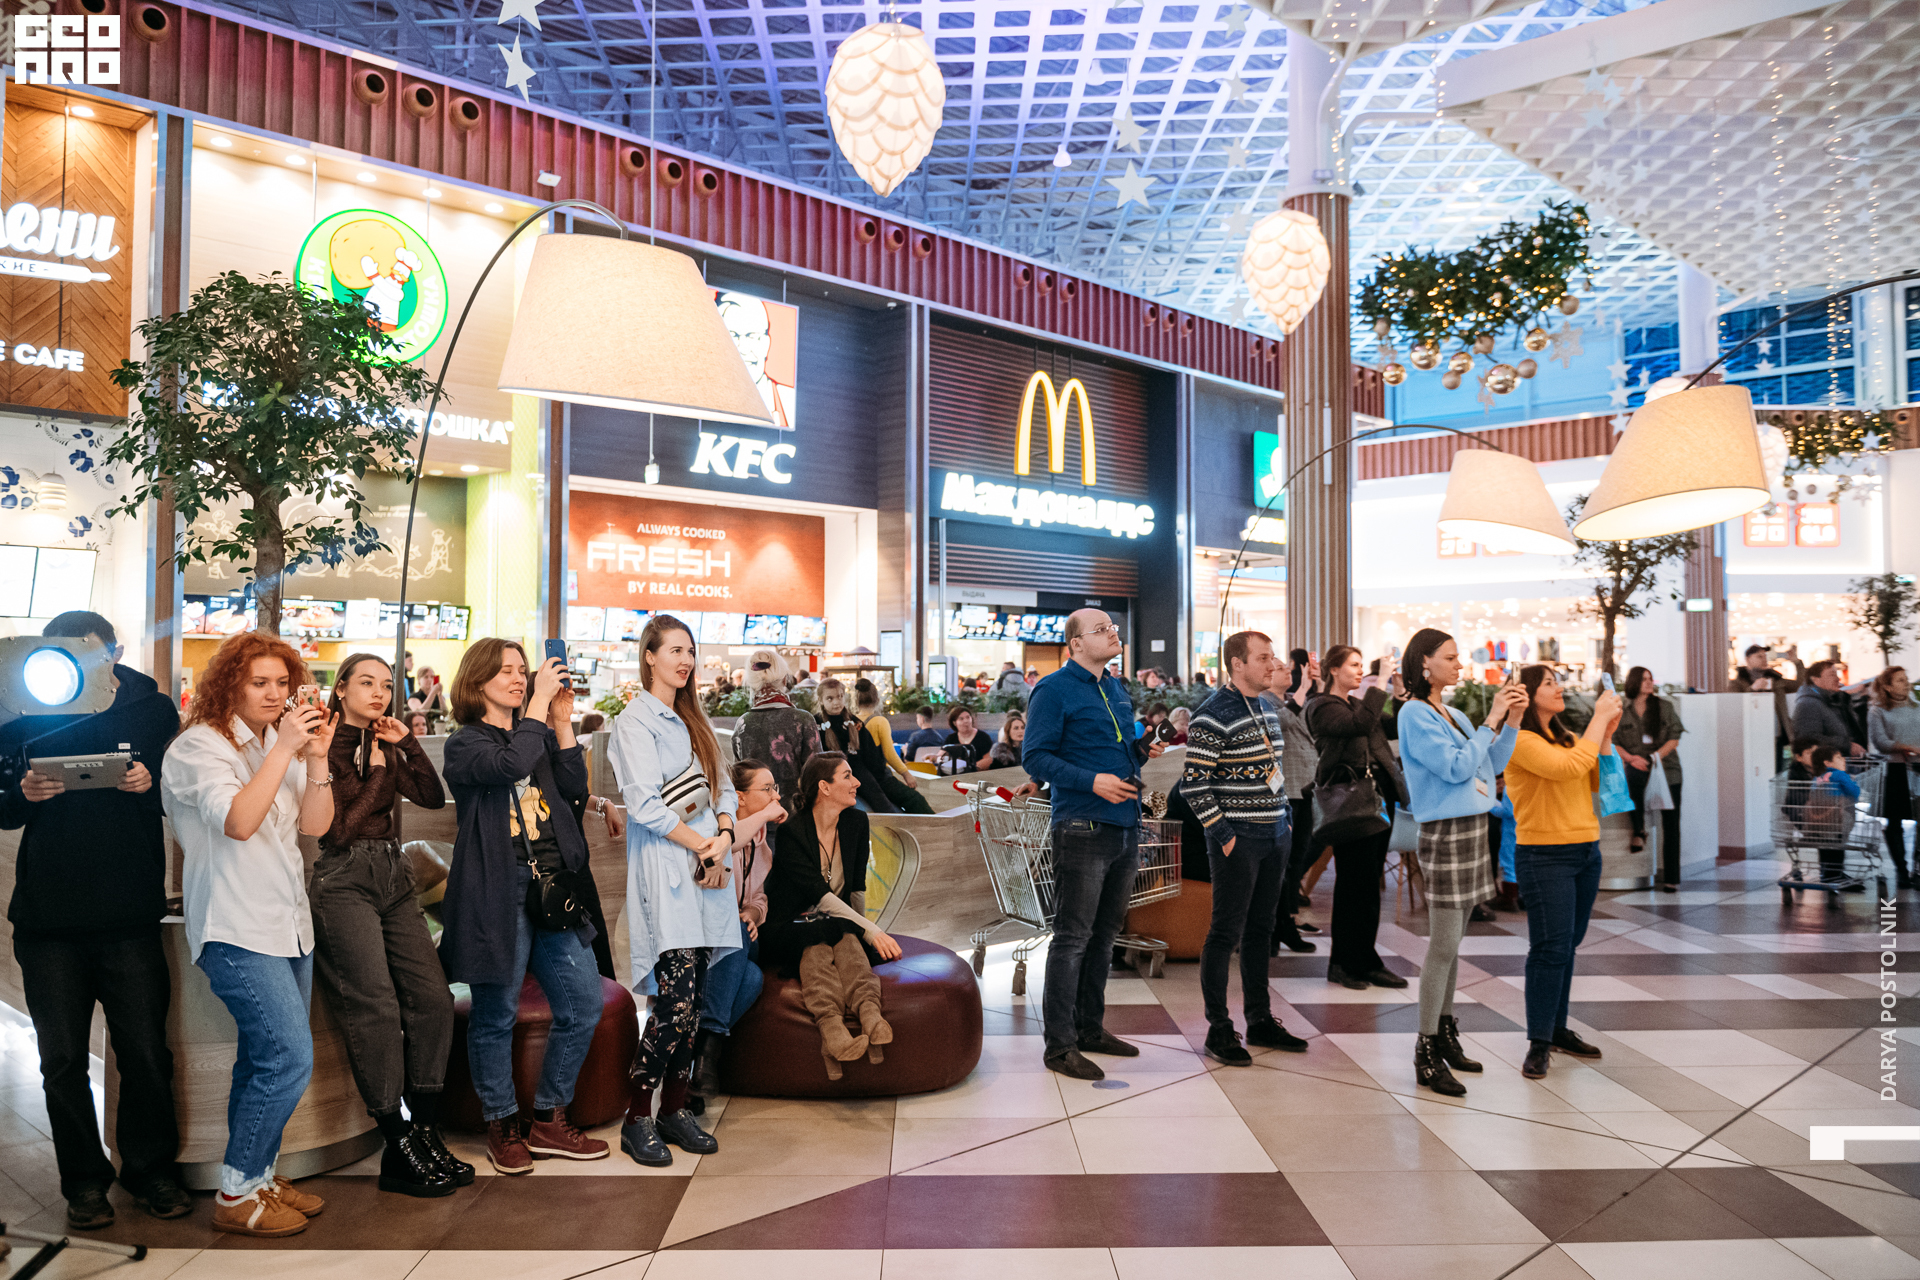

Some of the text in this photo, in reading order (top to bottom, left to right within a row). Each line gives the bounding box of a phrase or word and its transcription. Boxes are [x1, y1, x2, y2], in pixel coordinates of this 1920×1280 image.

[13, 343, 85, 372] CAFE
[689, 431, 797, 485] KFC
[940, 471, 1155, 539] Макдоналдс
[637, 523, 726, 541] ALWAYS COOKED
[586, 540, 731, 578] FRESH
[627, 580, 733, 599] BY REAL COOKS.
